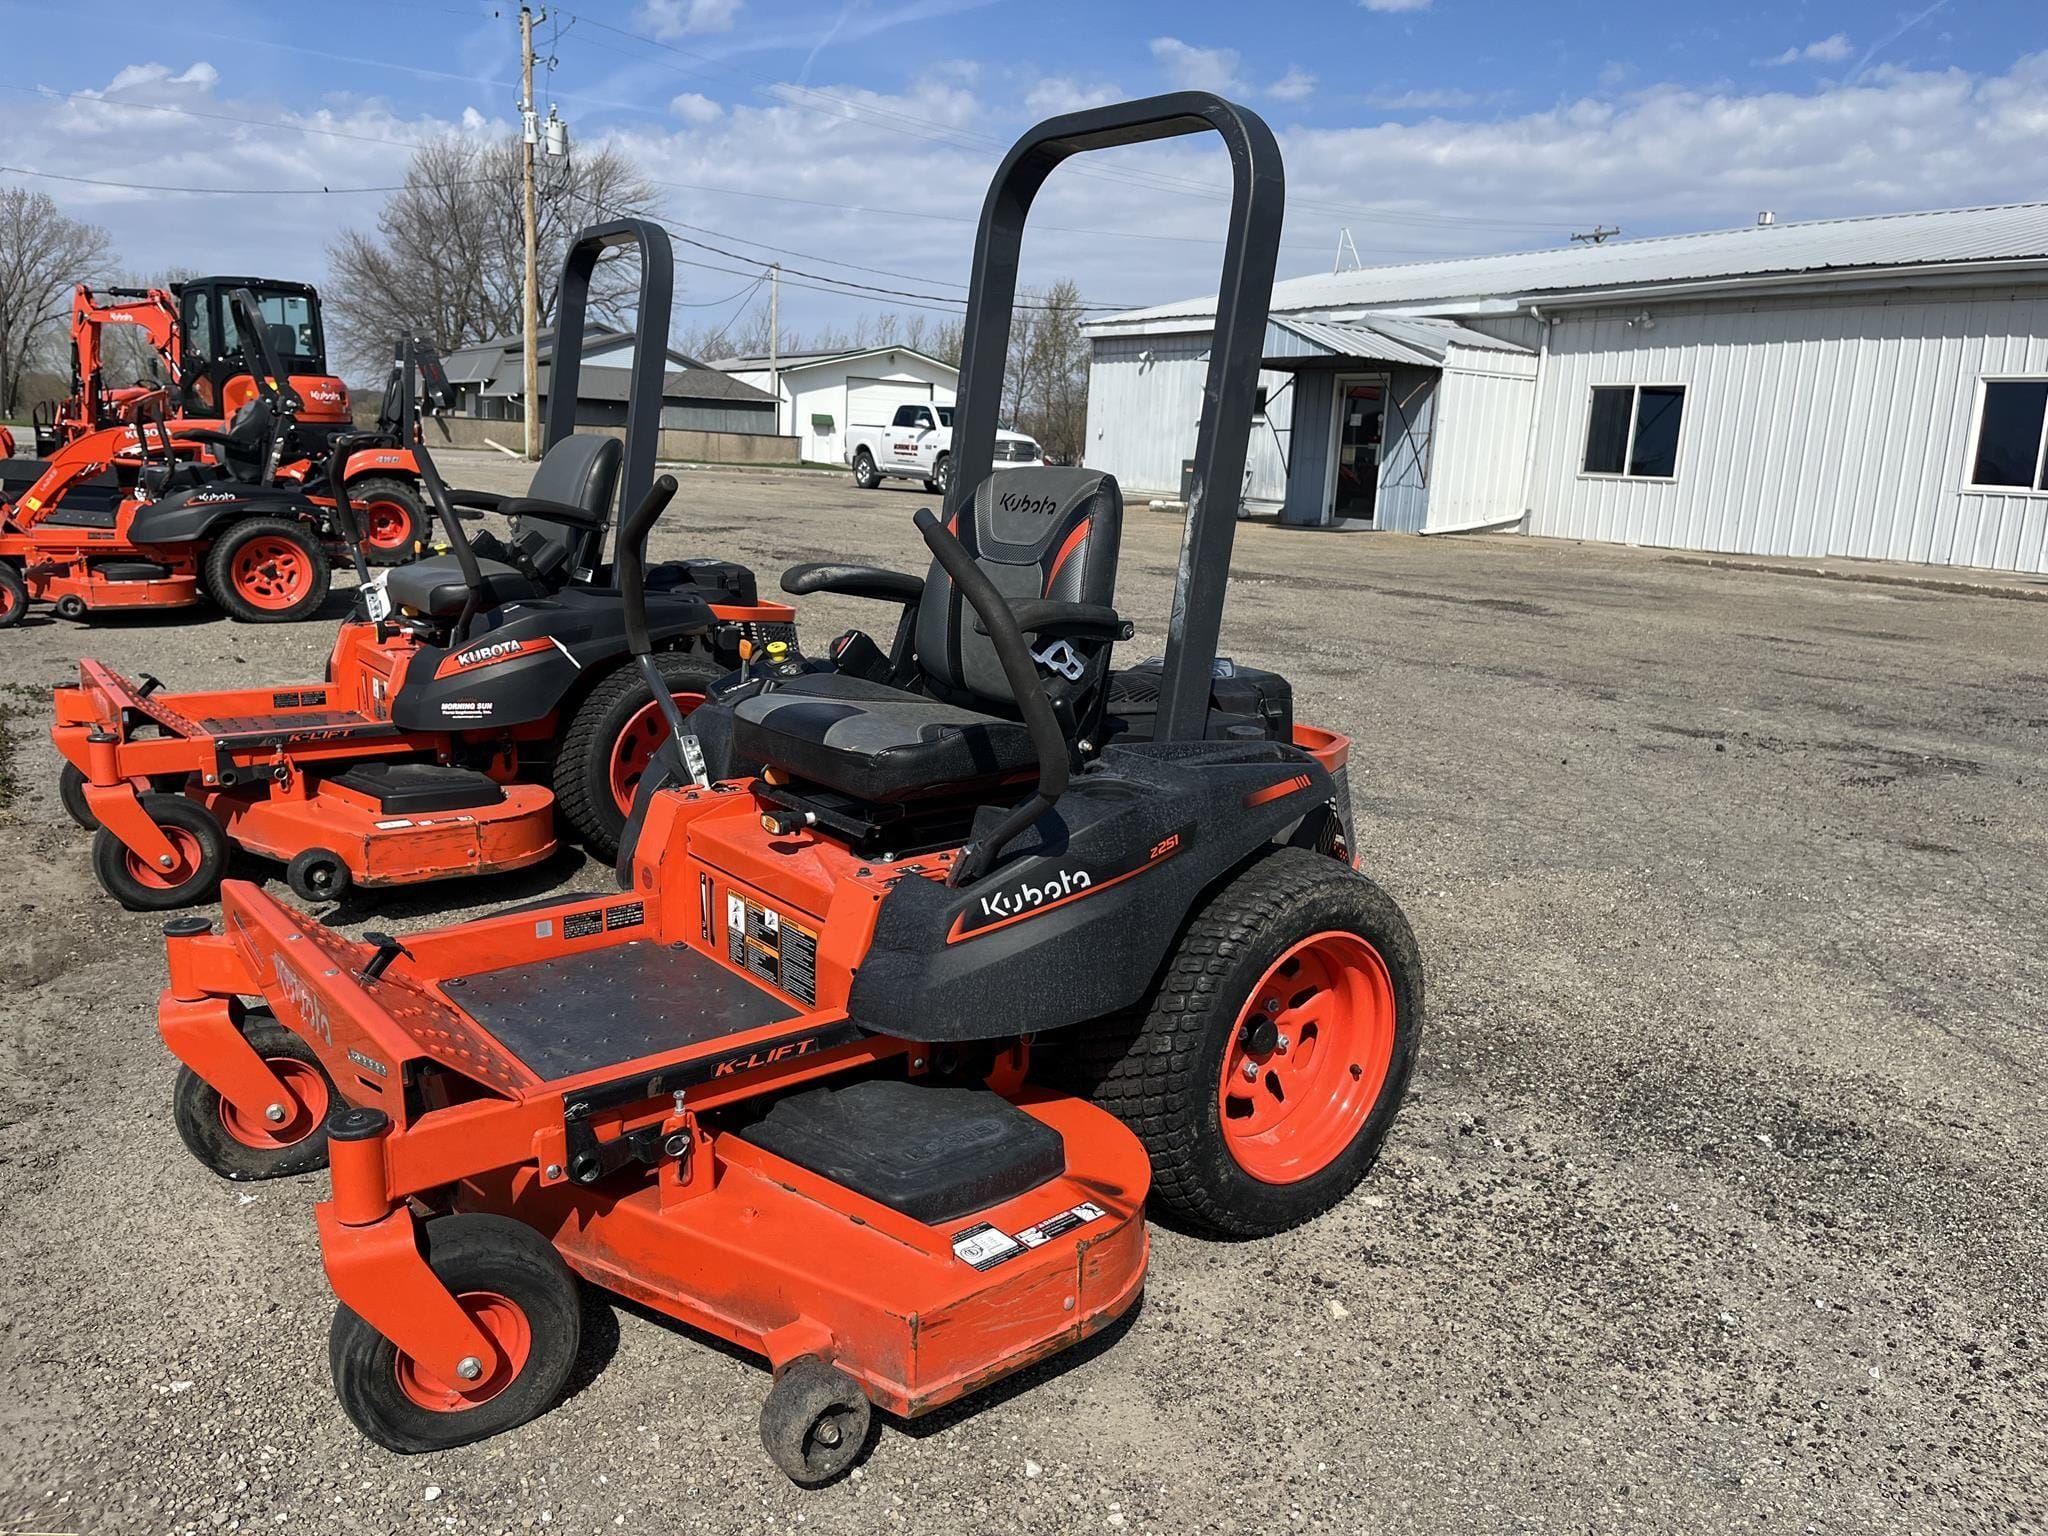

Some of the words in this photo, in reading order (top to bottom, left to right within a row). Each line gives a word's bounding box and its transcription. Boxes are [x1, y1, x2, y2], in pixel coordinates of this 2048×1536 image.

[199, 491, 236, 502] Kubota
[1000, 492, 1057, 515] Kubota
[457, 639, 522, 666] KUBOTA
[441, 702, 476, 711] MORNING
[477, 702, 493, 710] SUN
[289, 729, 351, 742] K-LIFT
[980, 870, 1091, 917] Kubota
[715, 1038, 815, 1077] K-LIFT
